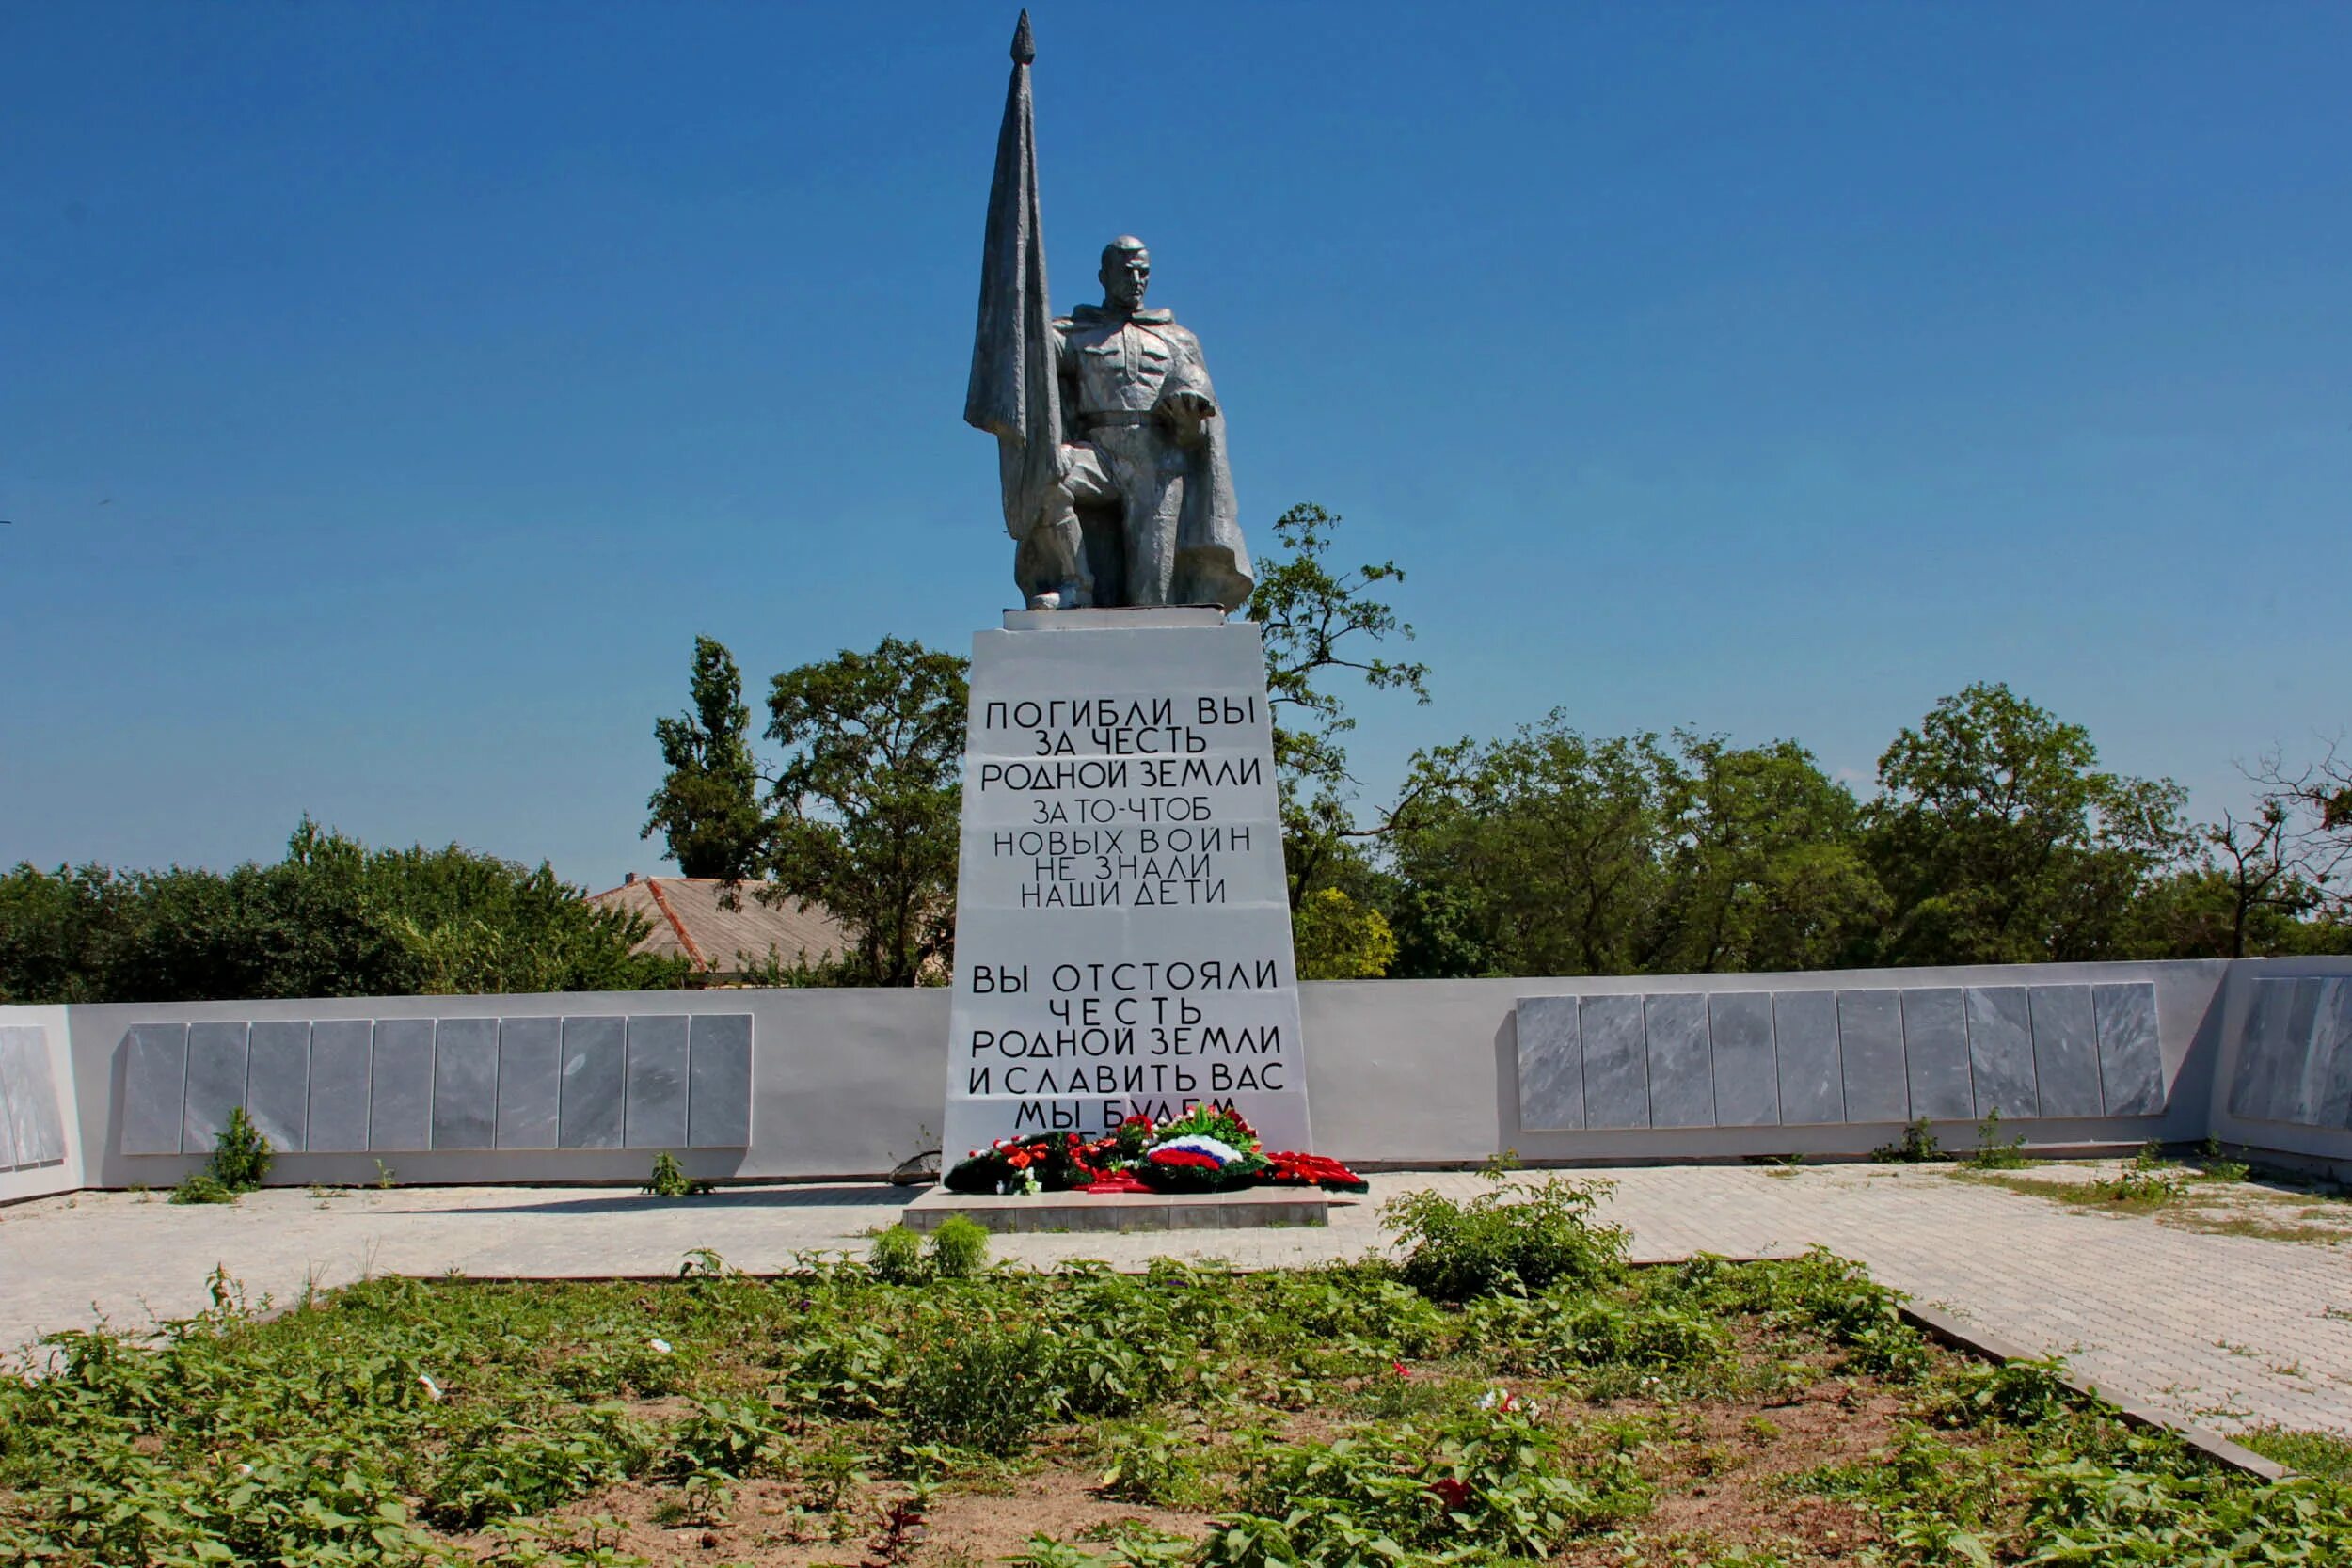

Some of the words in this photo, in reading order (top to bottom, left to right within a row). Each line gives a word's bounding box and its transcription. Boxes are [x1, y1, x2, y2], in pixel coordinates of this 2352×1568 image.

[986, 697, 1172, 729] ПОГИБЛИ
[1198, 696, 1255, 724] ВЫ
[1035, 730, 1075, 756] ЗА
[1091, 727, 1206, 755] ЧЕСТЬ
[981, 761, 1127, 791] РОДНОЙ
[1141, 759, 1261, 787] ЗЕМЛИ
[1033, 800, 1068, 824] ЗА
[1074, 797, 1211, 823] ТО-ЧТОБ
[994, 830, 1123, 856] НОВЫХ
[1140, 827, 1250, 852] ВОЙН
[1035, 858, 1075, 880] НЕ
[1096, 854, 1210, 879] ЗНАЛИ
[1022, 883, 1120, 908] НАШИ
[1134, 879, 1225, 906] ДЕТИ
[973, 965, 1028, 993] ВЫ
[1052, 960, 1278, 991] ОТСТОЯЛИ
[1049, 997, 1201, 1025] ЧЕСТЬ
[972, 1028, 1134, 1057] РОДНОЙ
[1151, 1026, 1281, 1054] ЗЕМЛИ
[969, 1067, 990, 1094] И
[1005, 1065, 1197, 1094] СЛАВИТЬ
[1212, 1063, 1283, 1090] ВАС
[1015, 1101, 1080, 1129] МЫ
